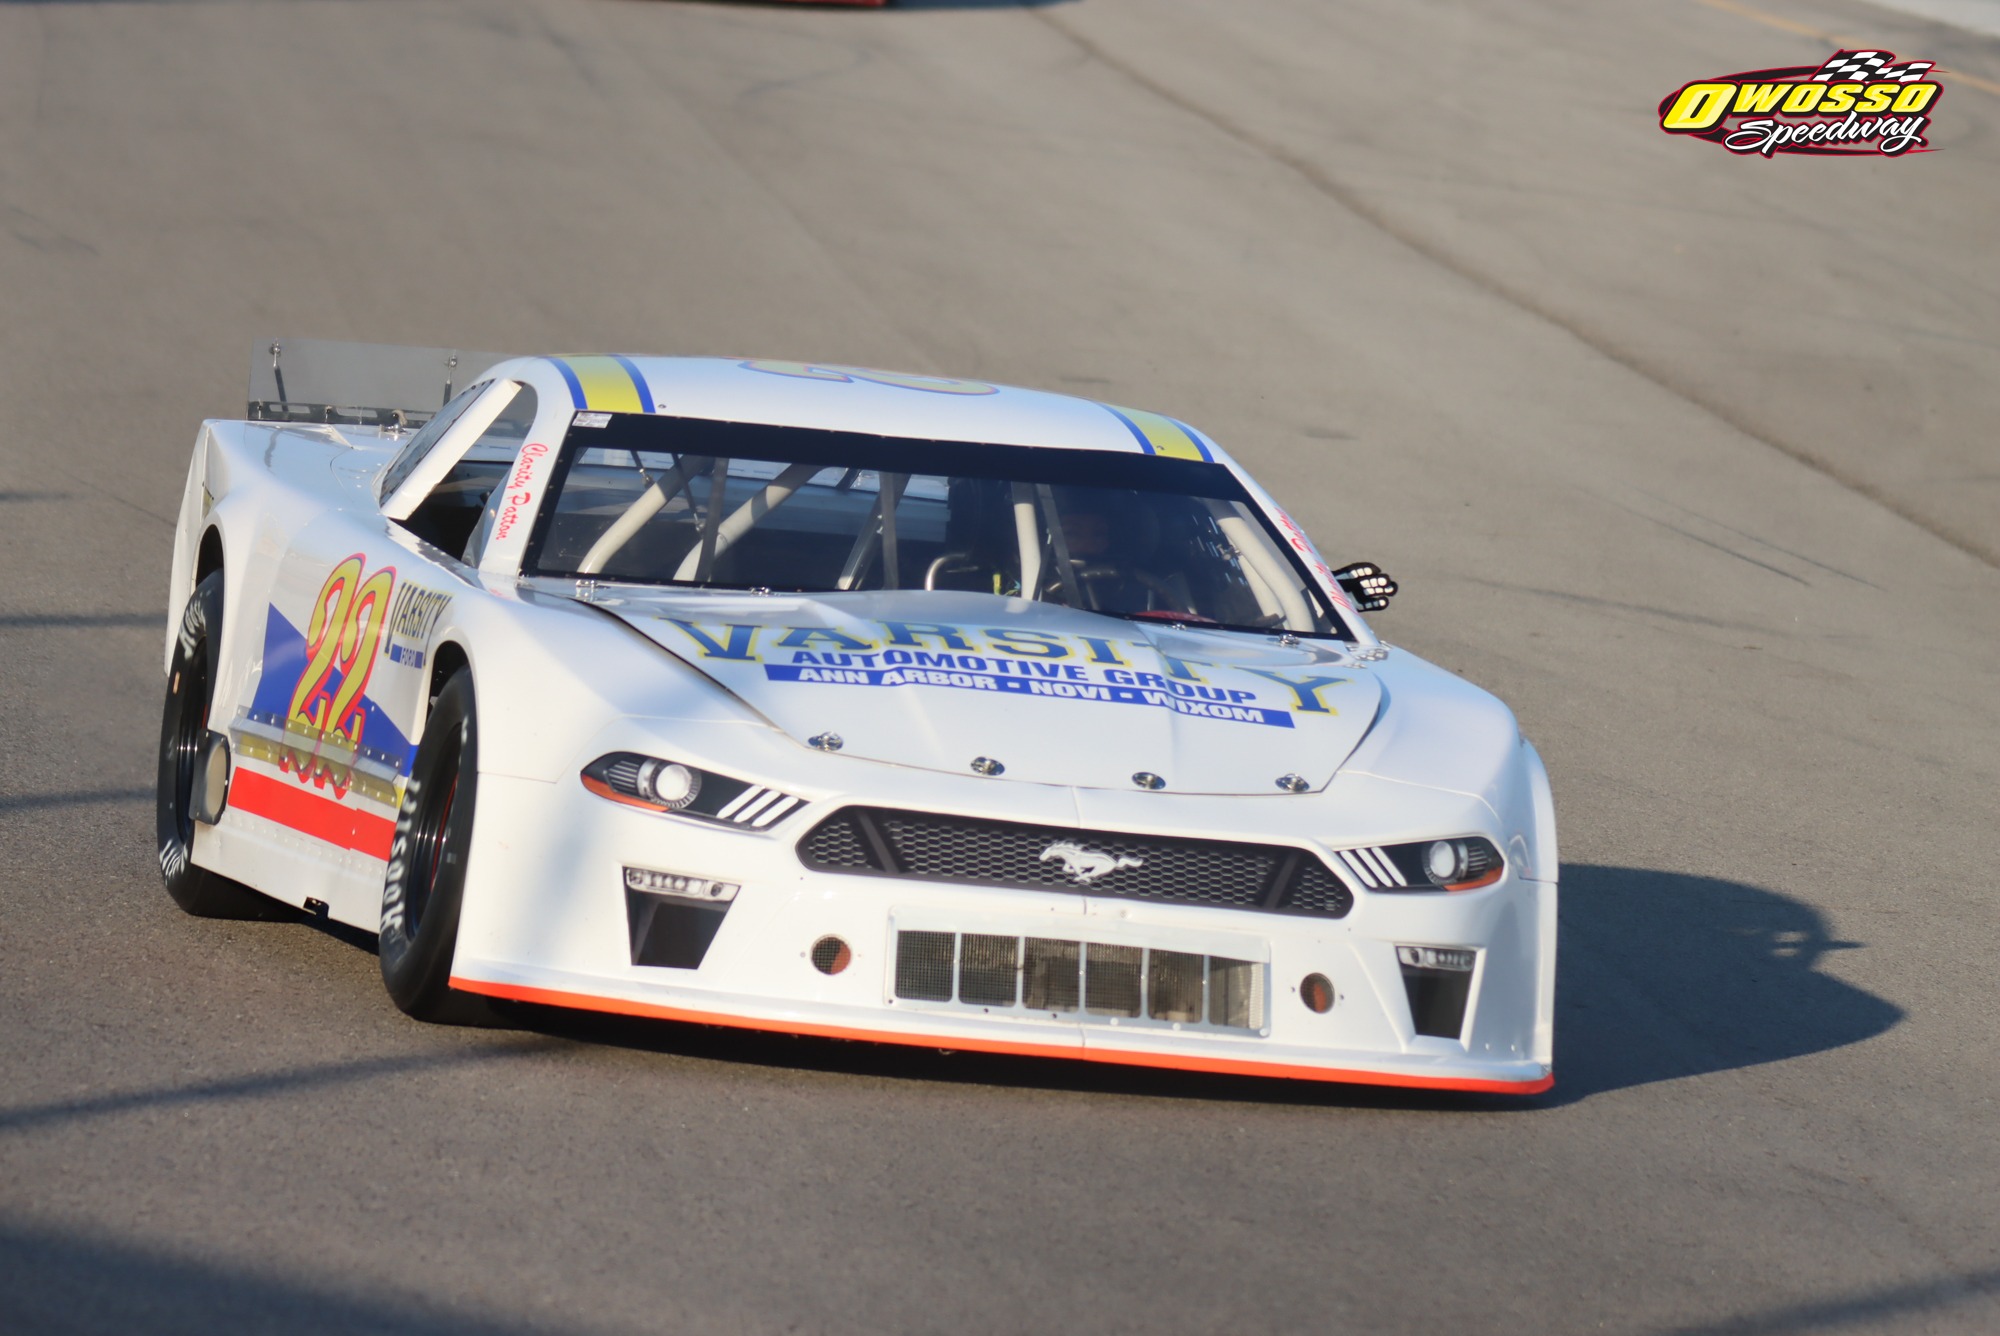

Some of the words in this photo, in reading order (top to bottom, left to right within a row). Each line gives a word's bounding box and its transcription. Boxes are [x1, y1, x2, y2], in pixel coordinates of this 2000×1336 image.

[384, 578, 454, 668] VARSITY
[652, 614, 1356, 716] VARSITY
[792, 649, 1089, 682] AUTOMOTIVE
[1103, 668, 1257, 704] GROUP
[798, 668, 870, 684] ANN
[881, 669, 998, 690] ARBOR
[1029, 680, 1112, 700] NOVI
[1136, 690, 1266, 723] WIXOM
